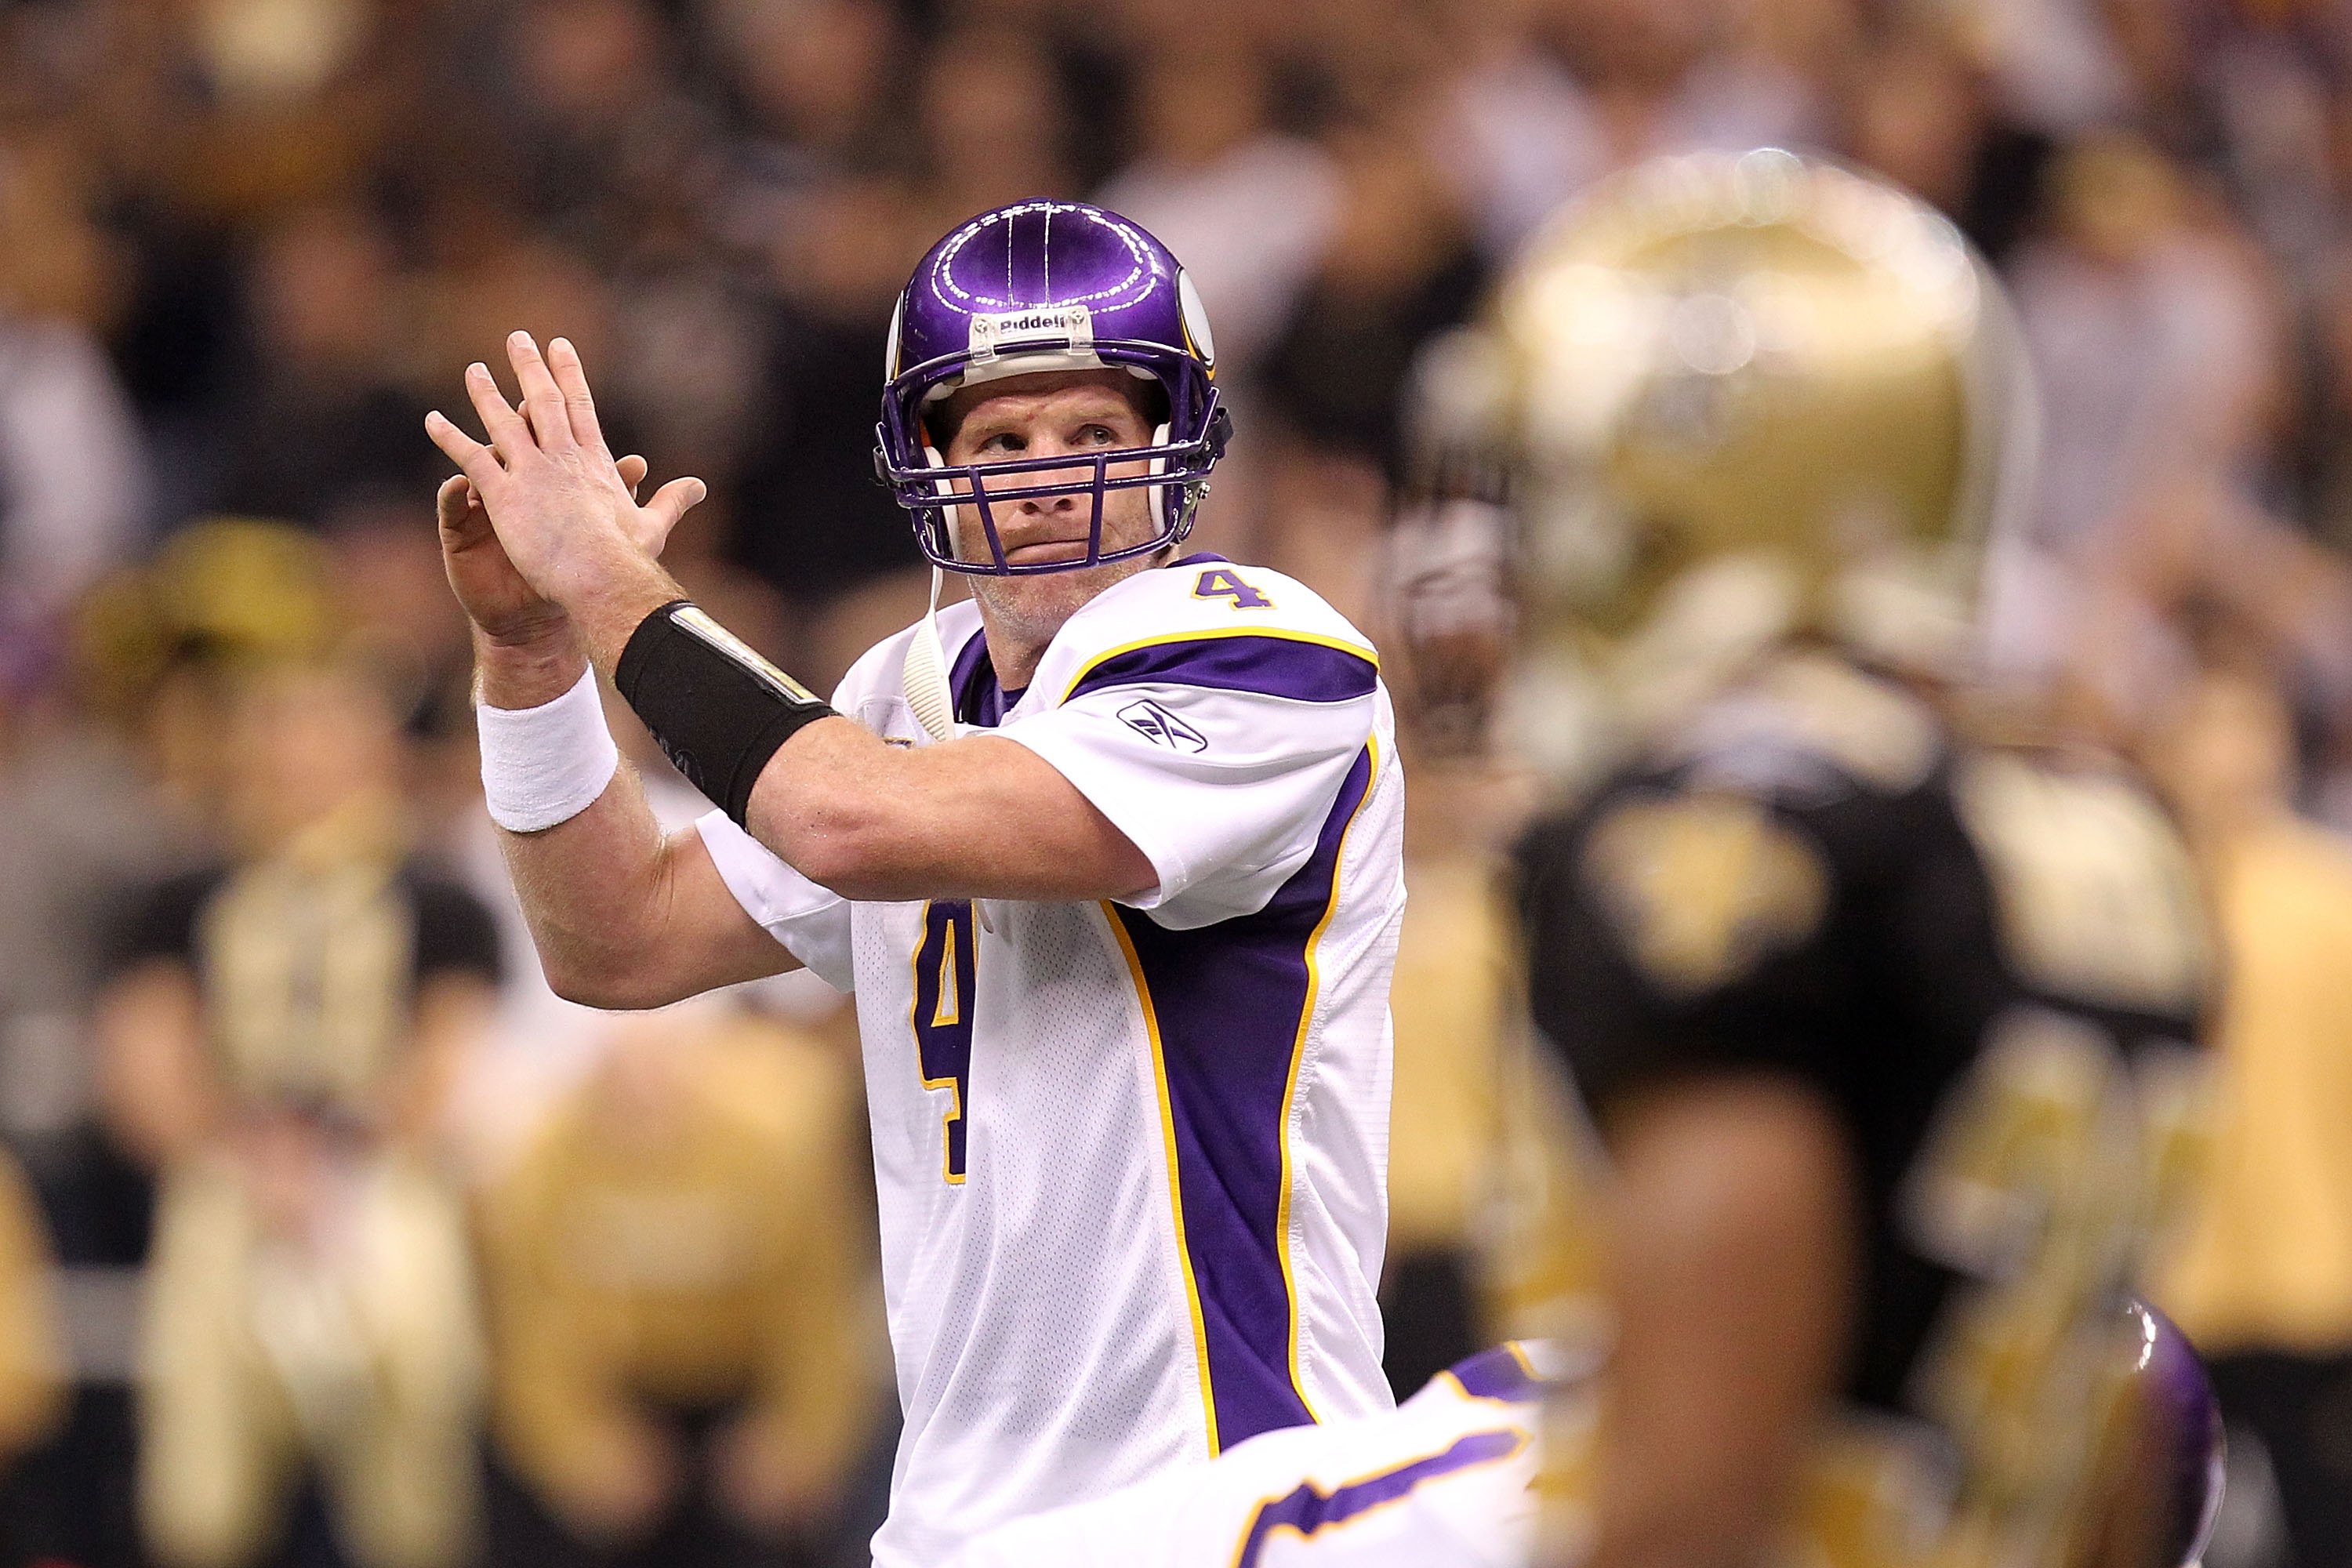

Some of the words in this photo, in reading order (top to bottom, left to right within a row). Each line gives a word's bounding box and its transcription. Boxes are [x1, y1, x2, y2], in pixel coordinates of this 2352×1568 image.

[1000, 314, 1066, 332] Riddell
[1190, 568, 1278, 610] 4
[910, 898, 978, 1185] 4
